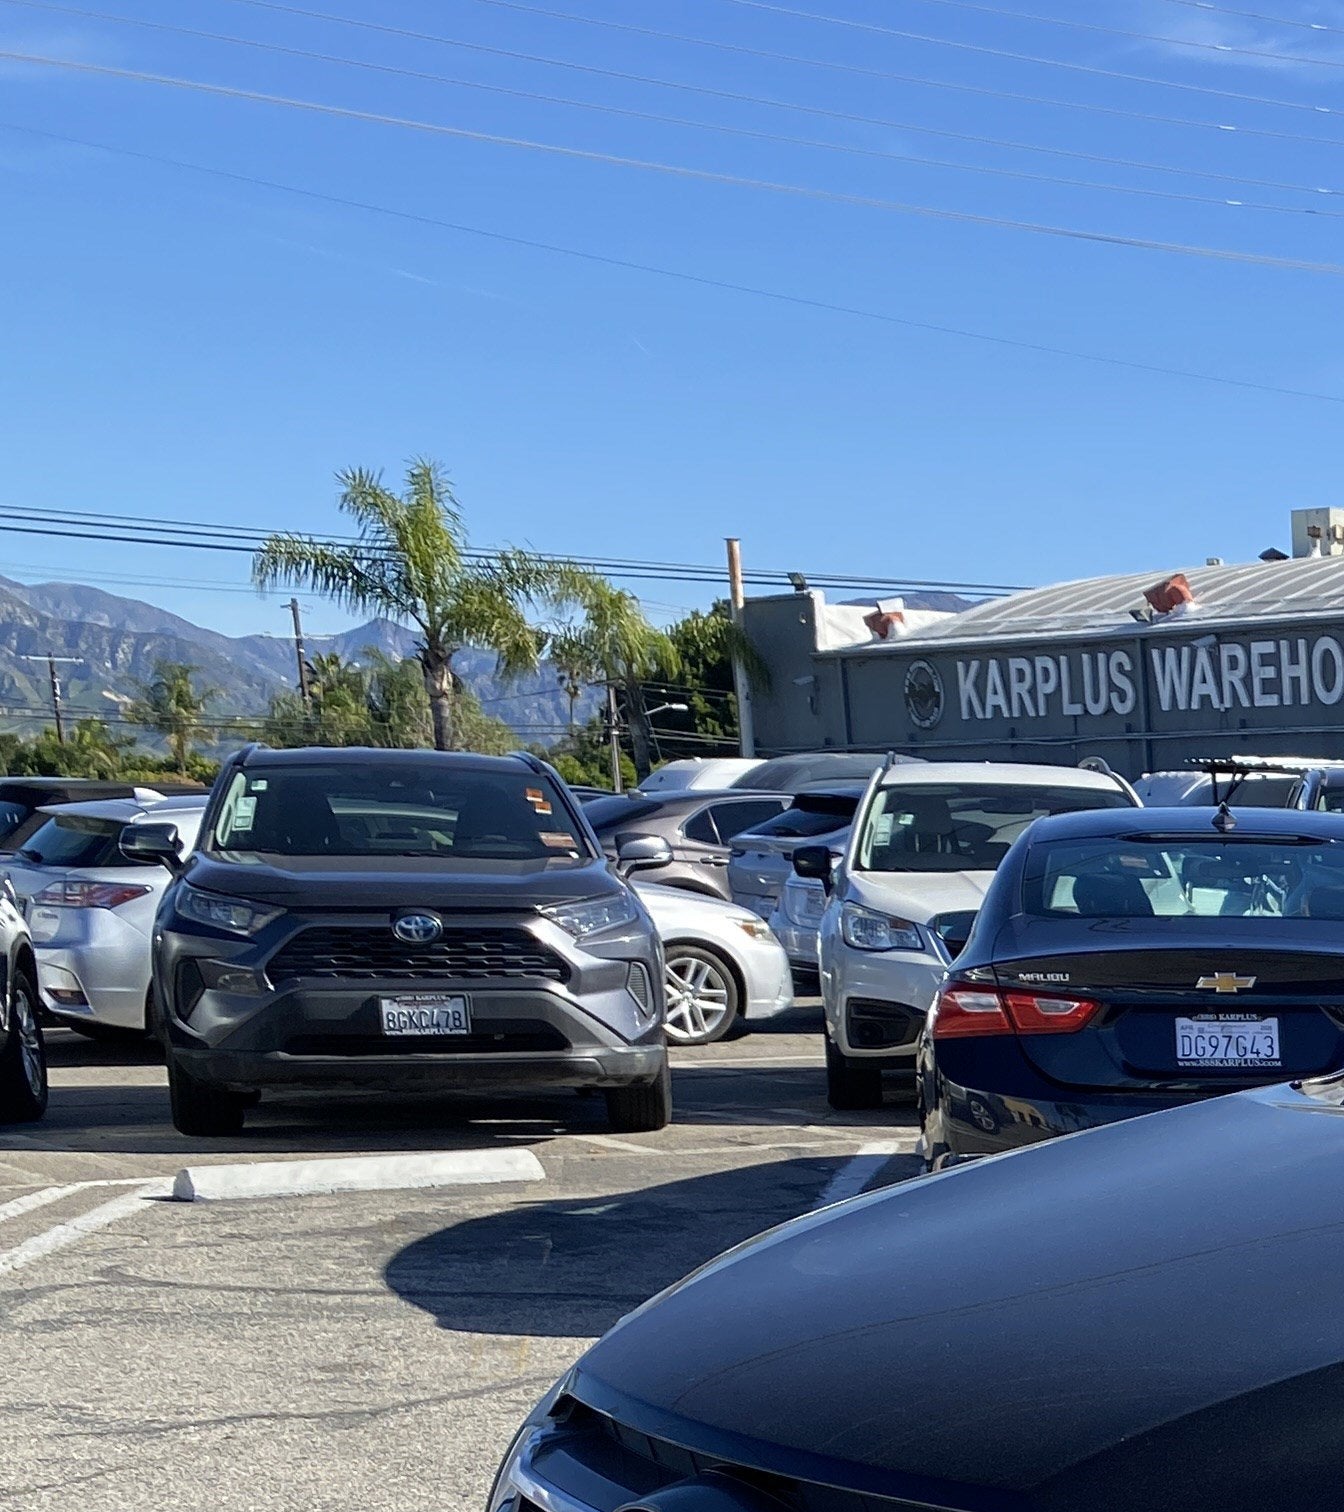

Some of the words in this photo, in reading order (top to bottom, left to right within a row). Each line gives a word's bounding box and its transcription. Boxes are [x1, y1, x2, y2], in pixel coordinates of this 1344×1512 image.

[956, 650, 1136, 720] KARPLUS
[1018, 972, 1070, 982] MALIBU
[1219, 1013, 1259, 1021] KARPLUS
[1180, 1034, 1275, 1058] DG97G43
